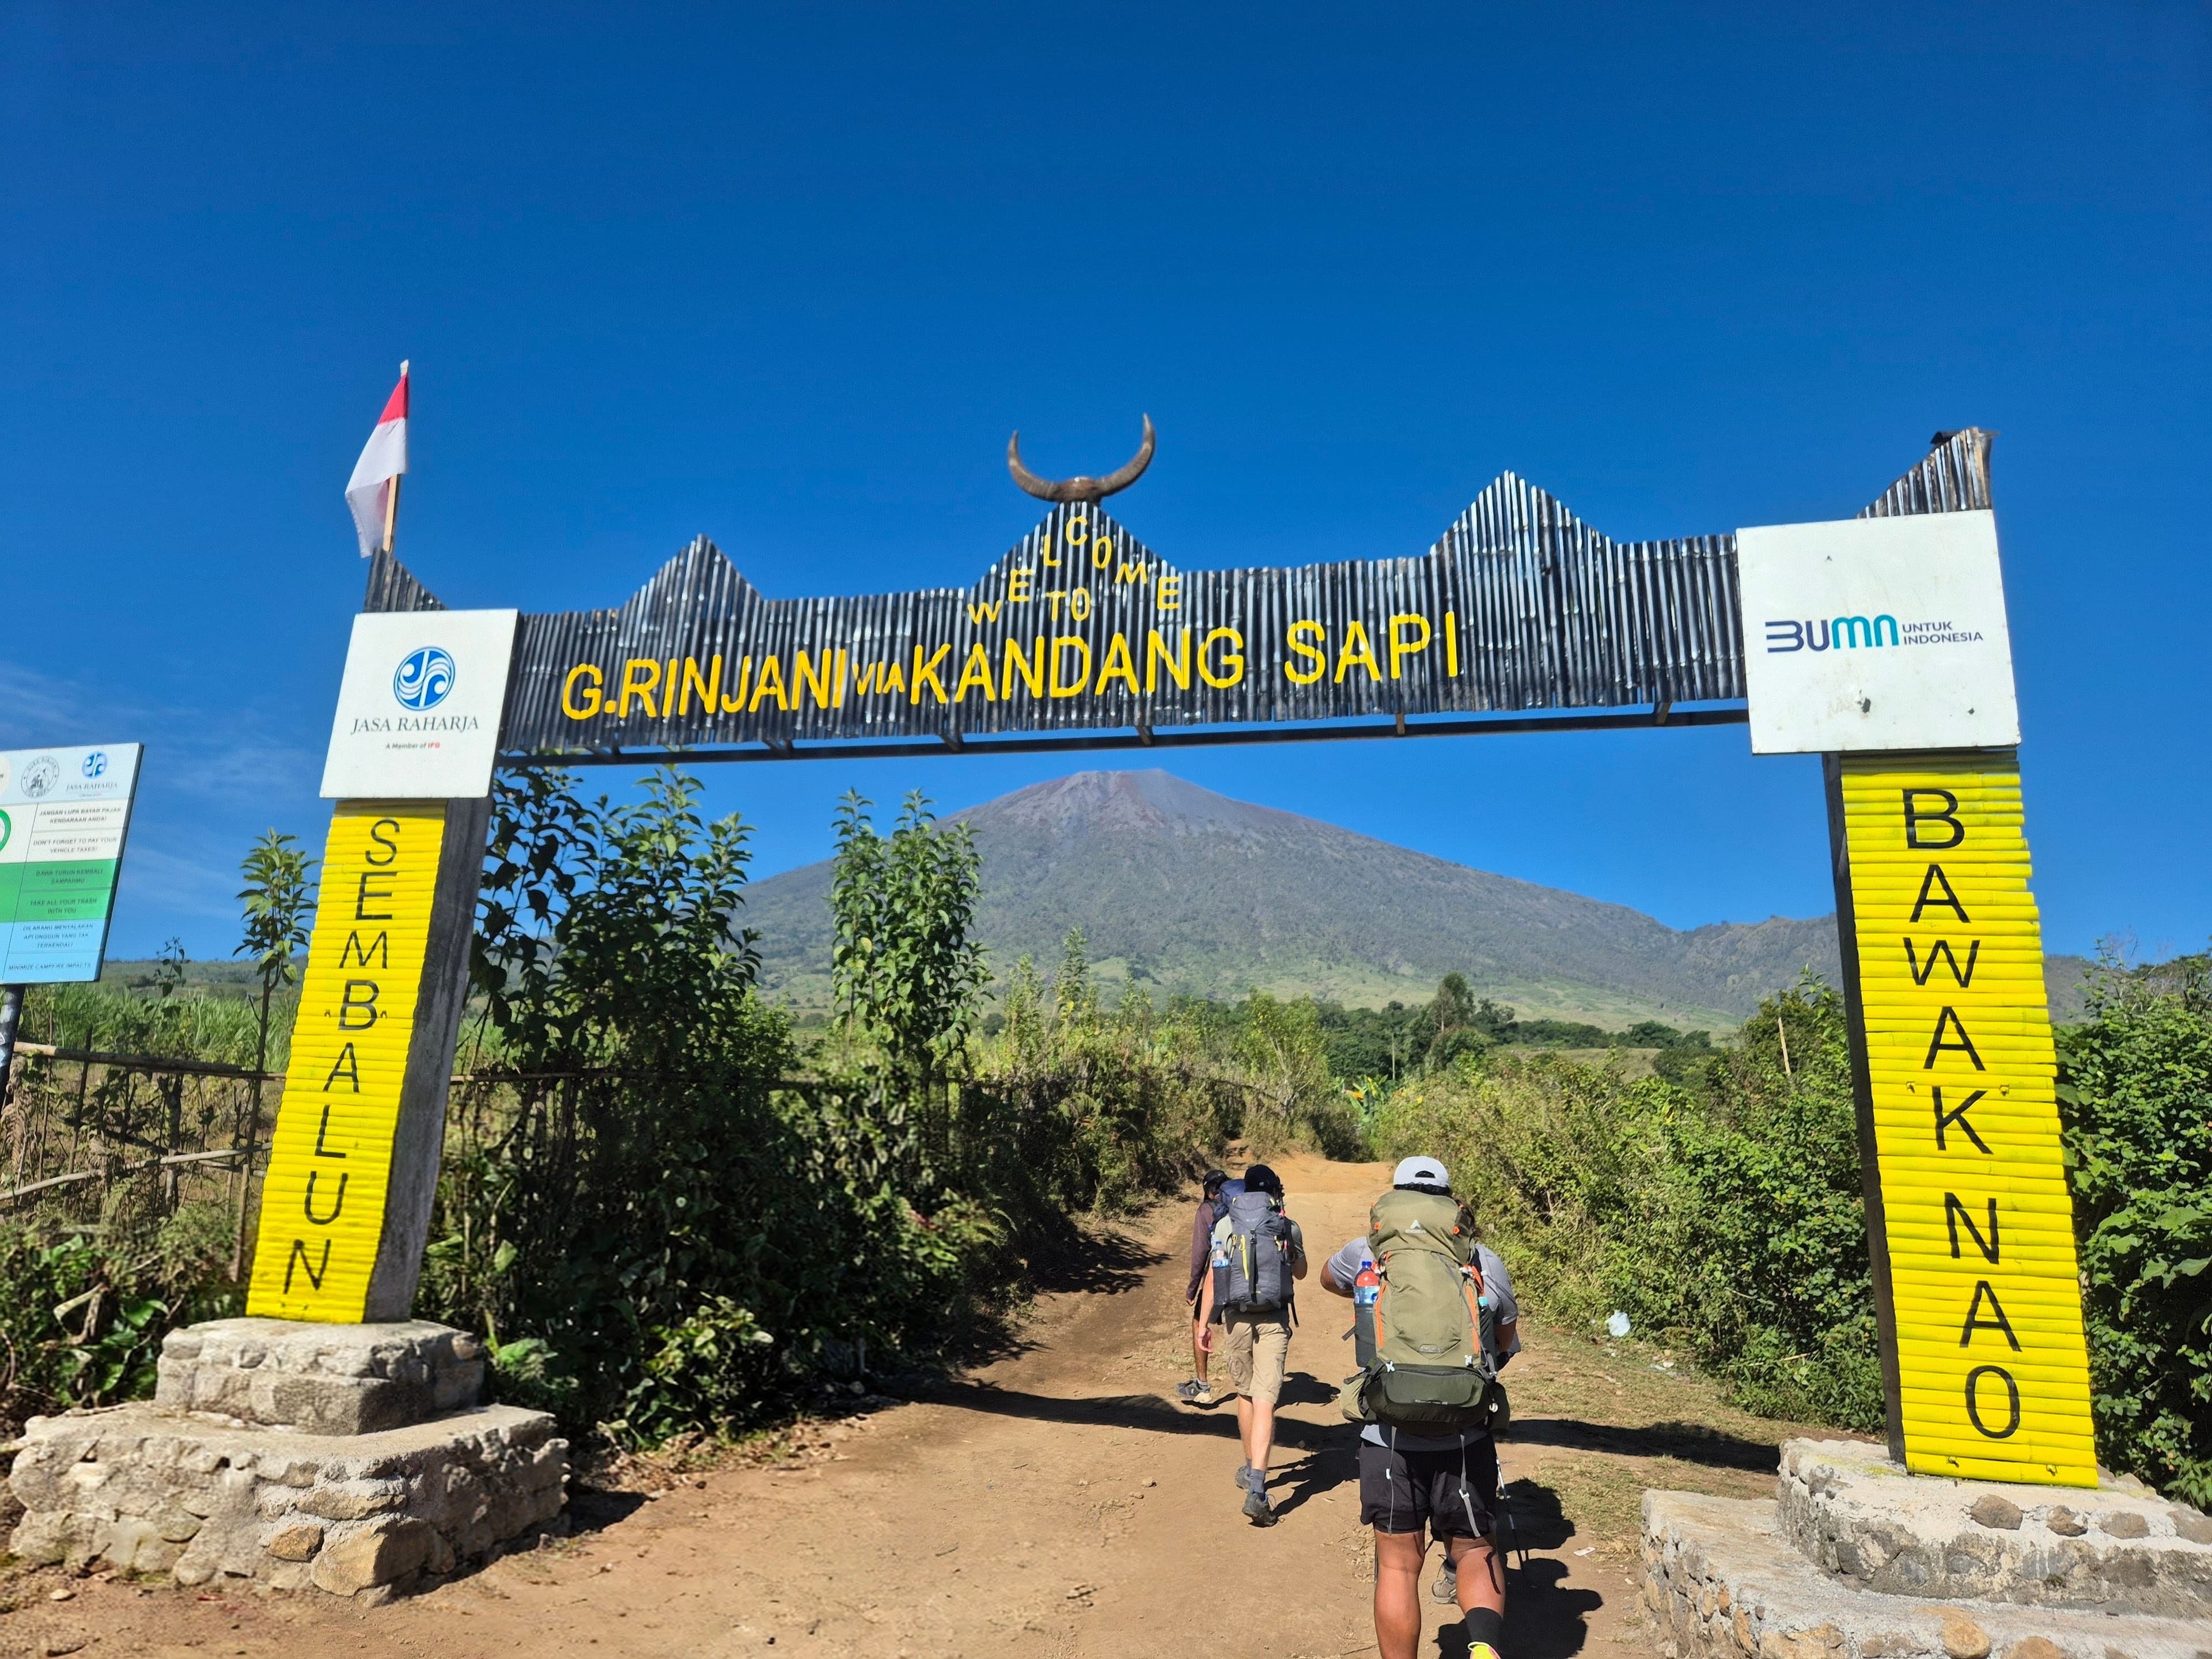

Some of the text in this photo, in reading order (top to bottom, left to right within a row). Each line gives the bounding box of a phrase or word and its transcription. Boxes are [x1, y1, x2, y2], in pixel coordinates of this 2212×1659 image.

[967, 516, 1180, 624] WELCOME
[1046, 587, 1090, 622] TO
[1902, 621, 1953, 633] UNTUK
[1903, 631, 1983, 646] INDONESIA
[562, 611, 1458, 719] G.RINJANI VIA KANDANG SAPI
[350, 715, 479, 736] JASA RAHARJA
[283, 817, 401, 1295] SEMBALUN
